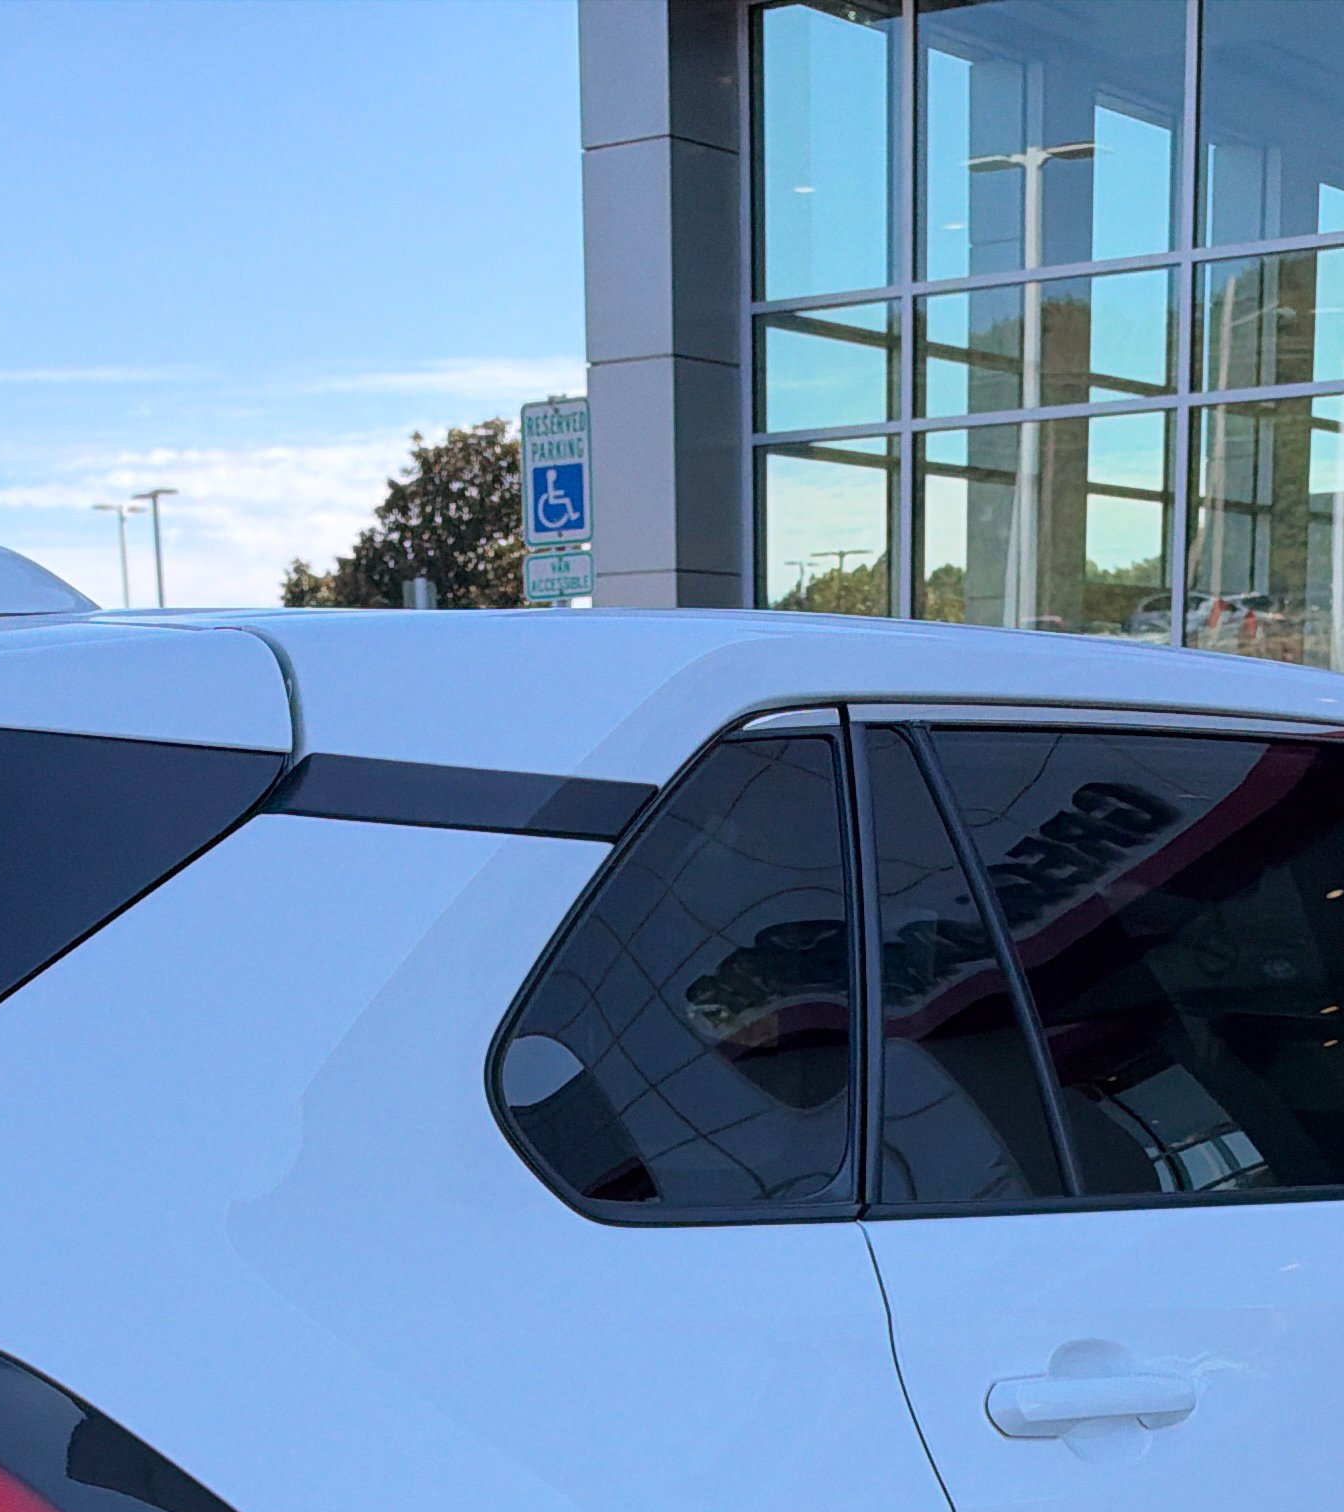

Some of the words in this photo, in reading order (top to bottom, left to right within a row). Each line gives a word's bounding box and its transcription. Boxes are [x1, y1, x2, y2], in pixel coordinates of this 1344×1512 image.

[526, 411, 586, 437] RESERVED
[531, 437, 585, 462] PARKING
[550, 560, 571, 573] VAN
[532, 574, 589, 593] ACCESSIBLE
